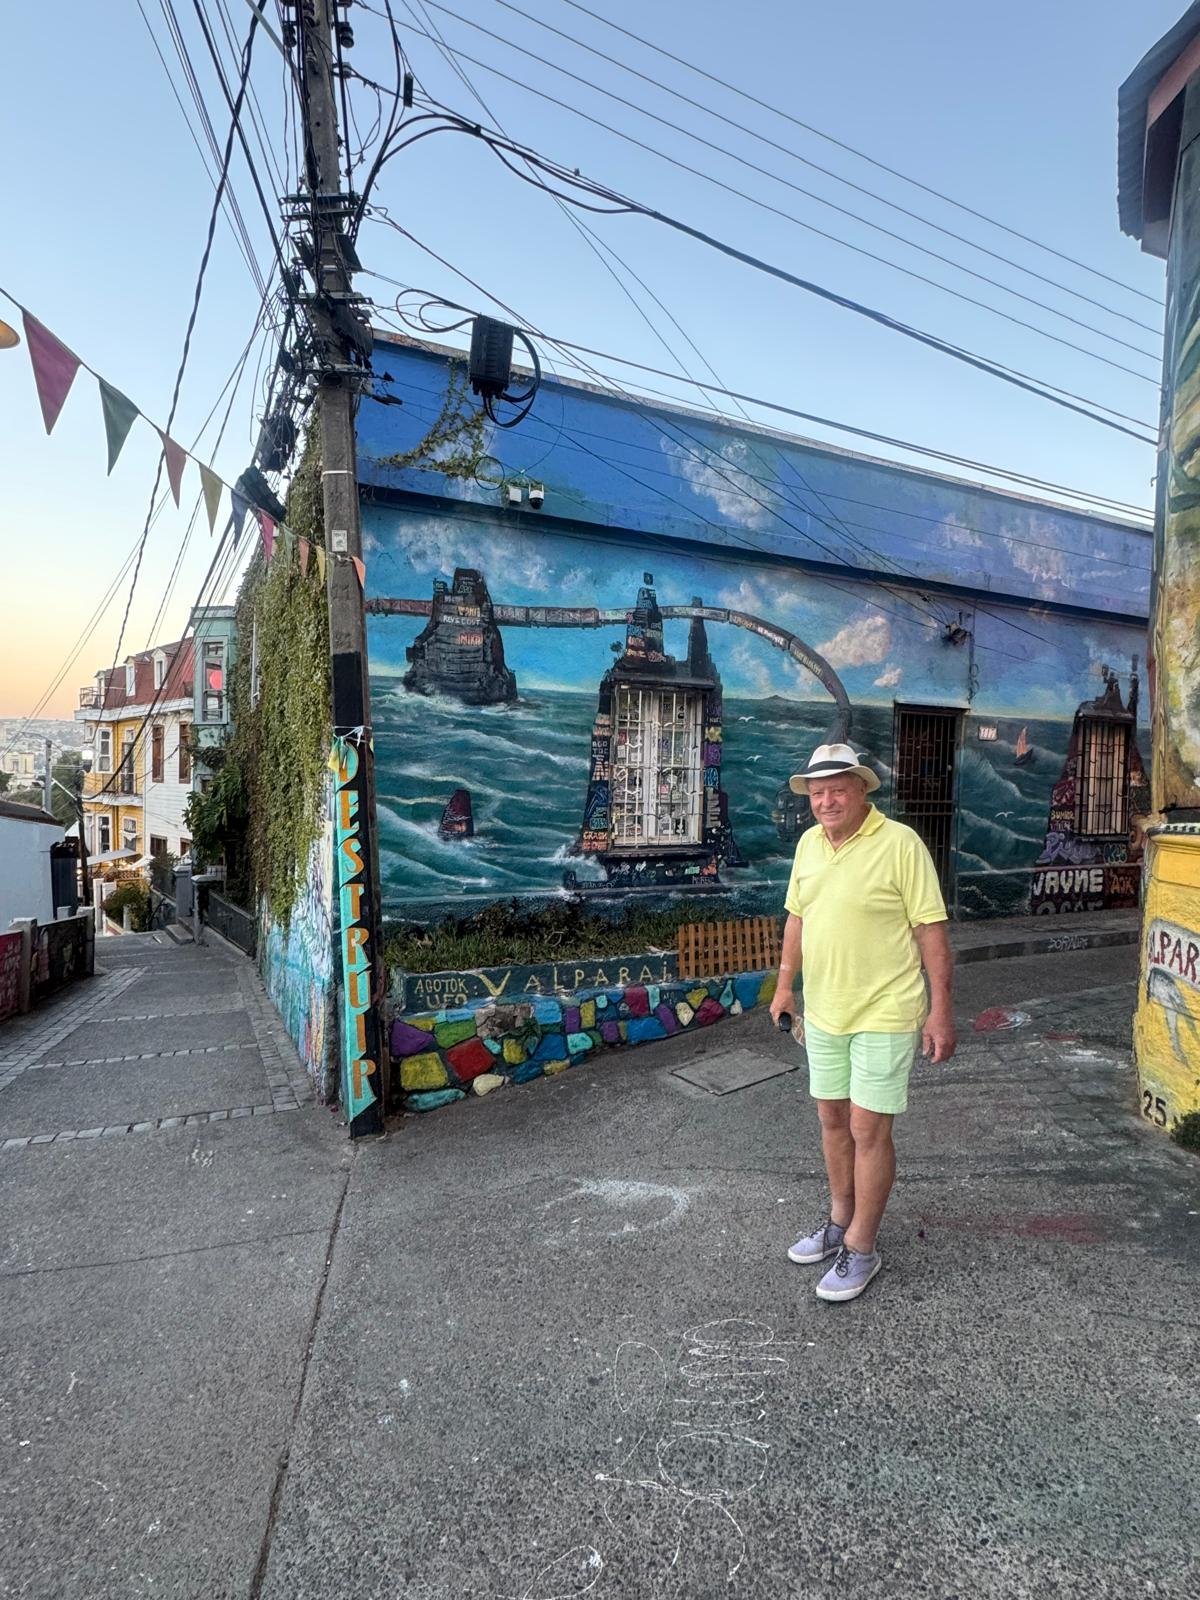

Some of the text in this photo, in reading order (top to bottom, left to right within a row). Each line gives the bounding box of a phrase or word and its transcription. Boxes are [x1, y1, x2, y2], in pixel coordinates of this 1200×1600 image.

[338, 742, 377, 1101] DESTRUIR
[1149, 931, 1200, 984] LPAR
[1143, 1090, 1166, 1127] 25
